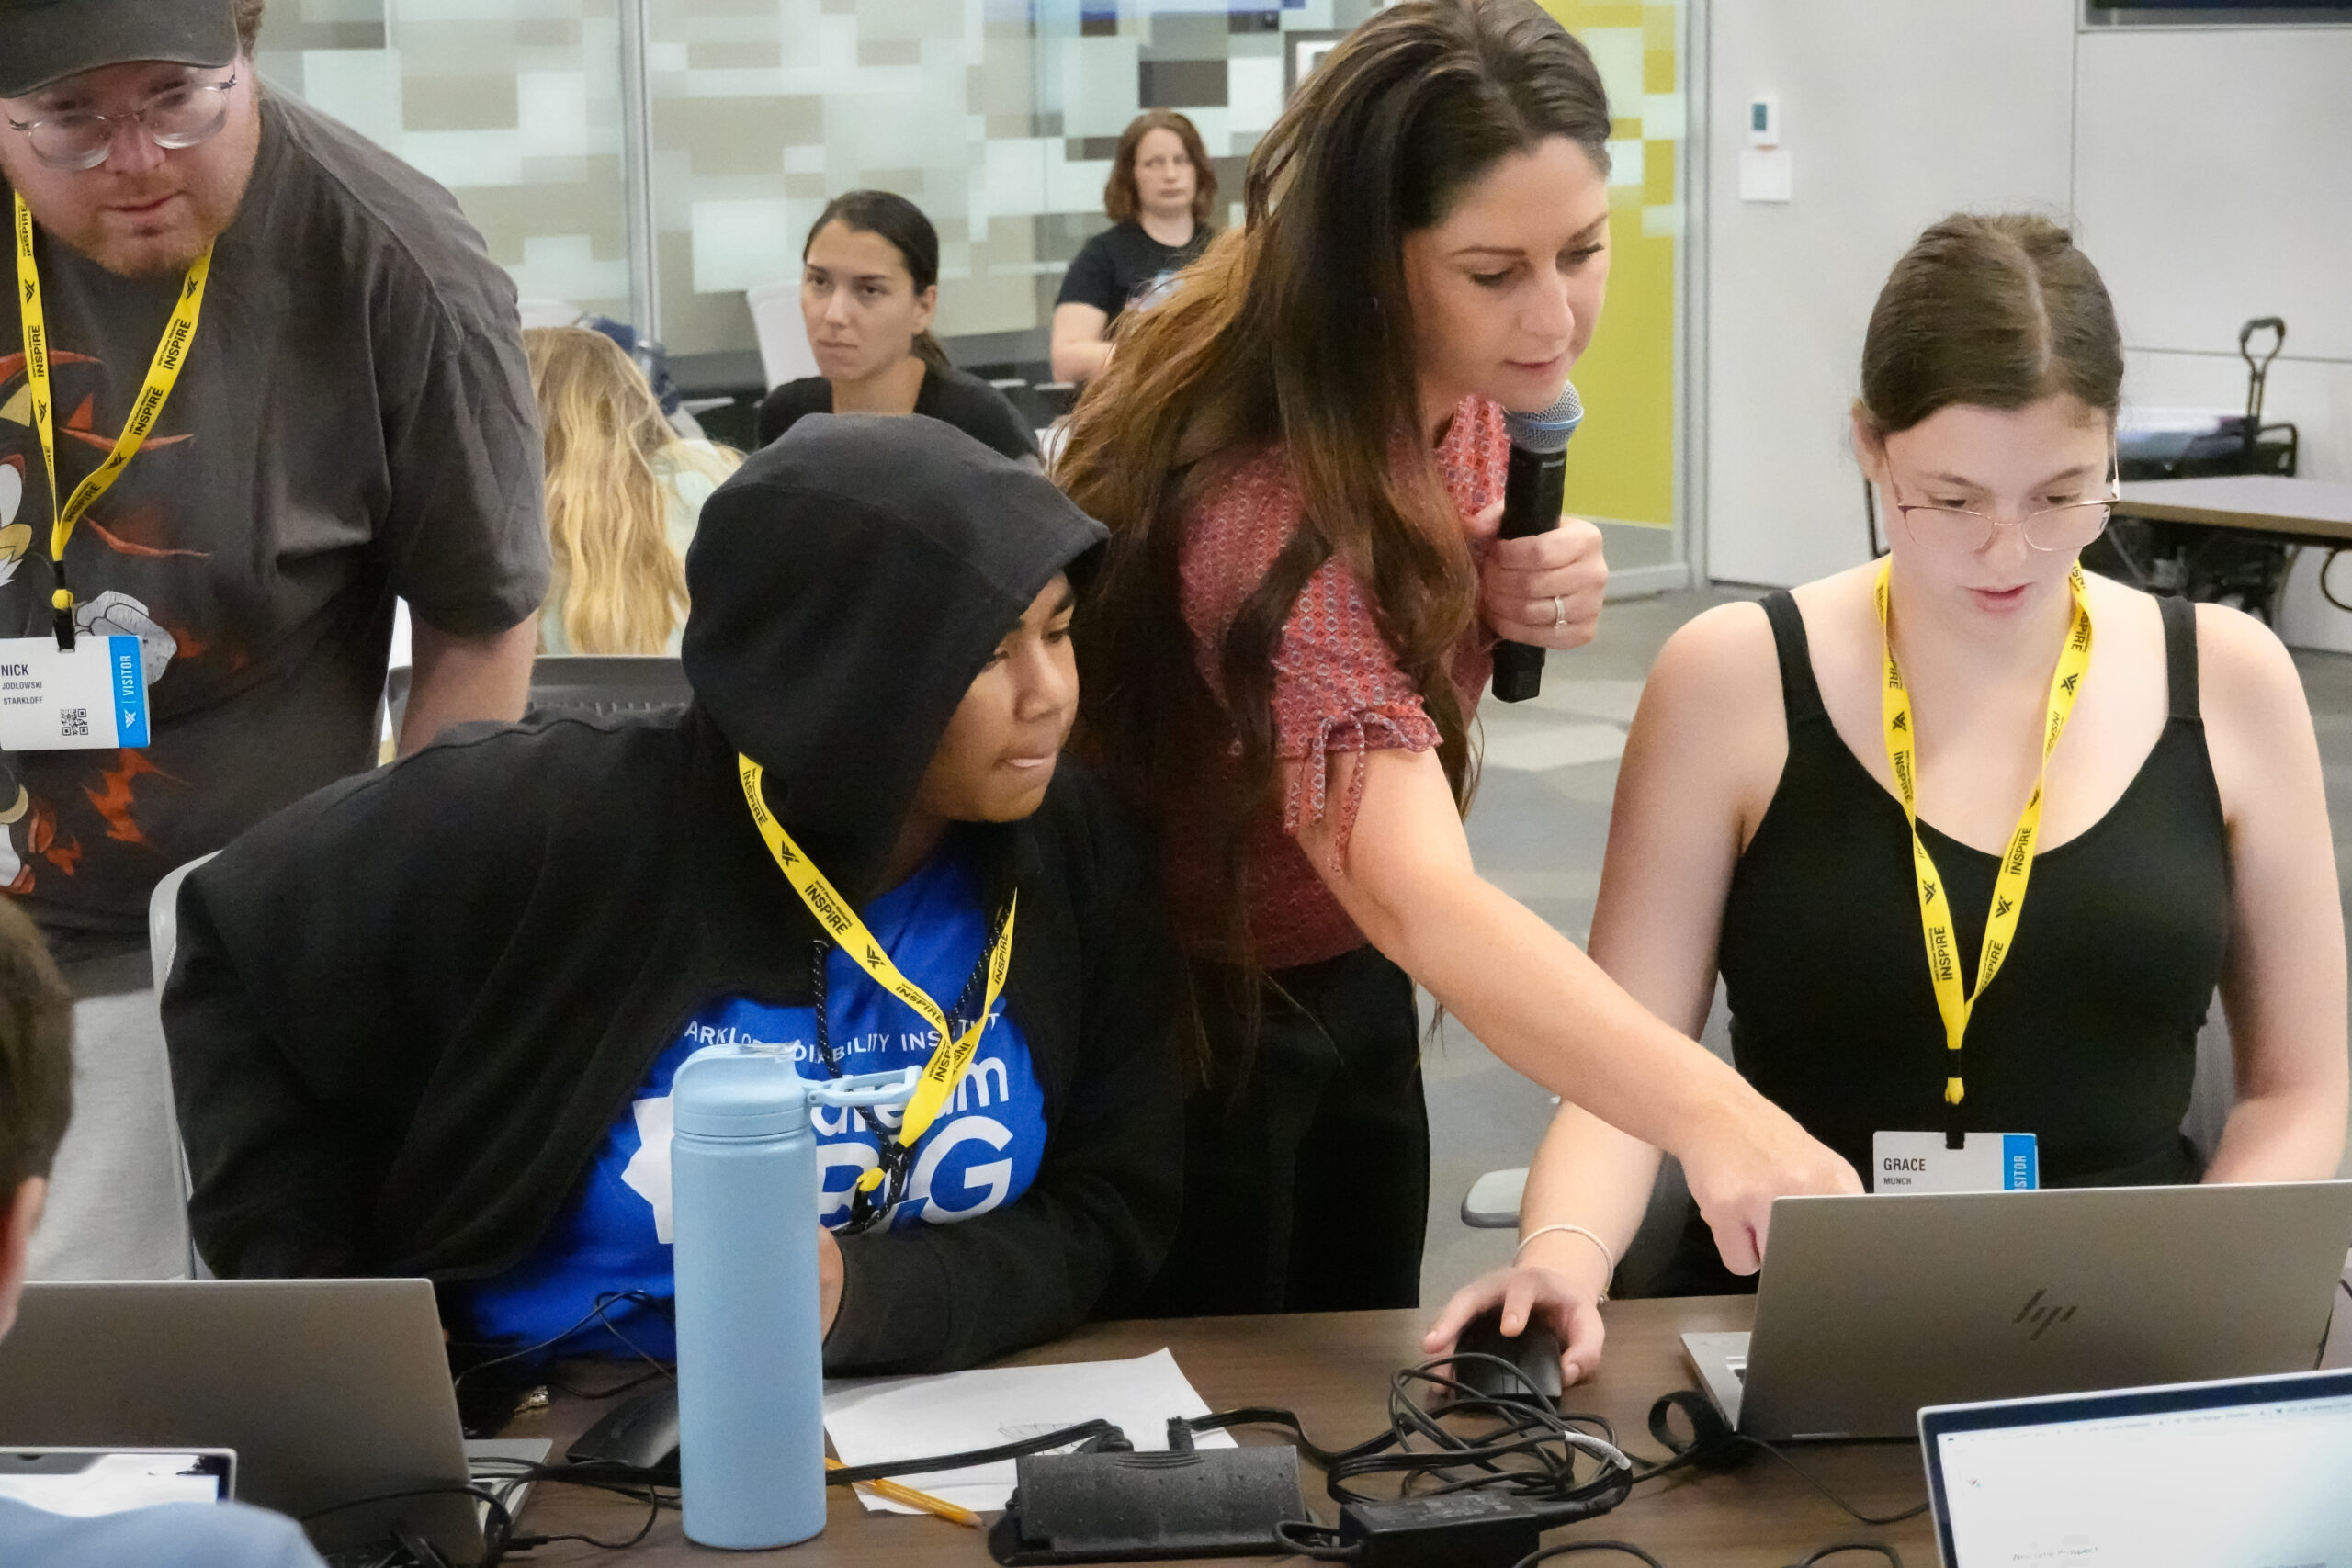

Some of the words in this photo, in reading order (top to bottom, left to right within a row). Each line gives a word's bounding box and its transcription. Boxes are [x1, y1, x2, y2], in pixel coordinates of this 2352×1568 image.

[2071, 611, 2088, 651] SPIRE
[1, 664, 28, 676] NICK
[119, 655, 135, 696] VISITOR
[3, 682, 42, 690] JODLOWSKI
[3, 696, 43, 705] STARKLOFF
[794, 1033, 889, 1064] DIBILITY
[810, 1057, 1009, 1136] drem
[1883, 1157, 1926, 1171] GRACE
[2014, 1155, 2027, 1190] SITOR
[1883, 1177, 1912, 1185] MUNCH
